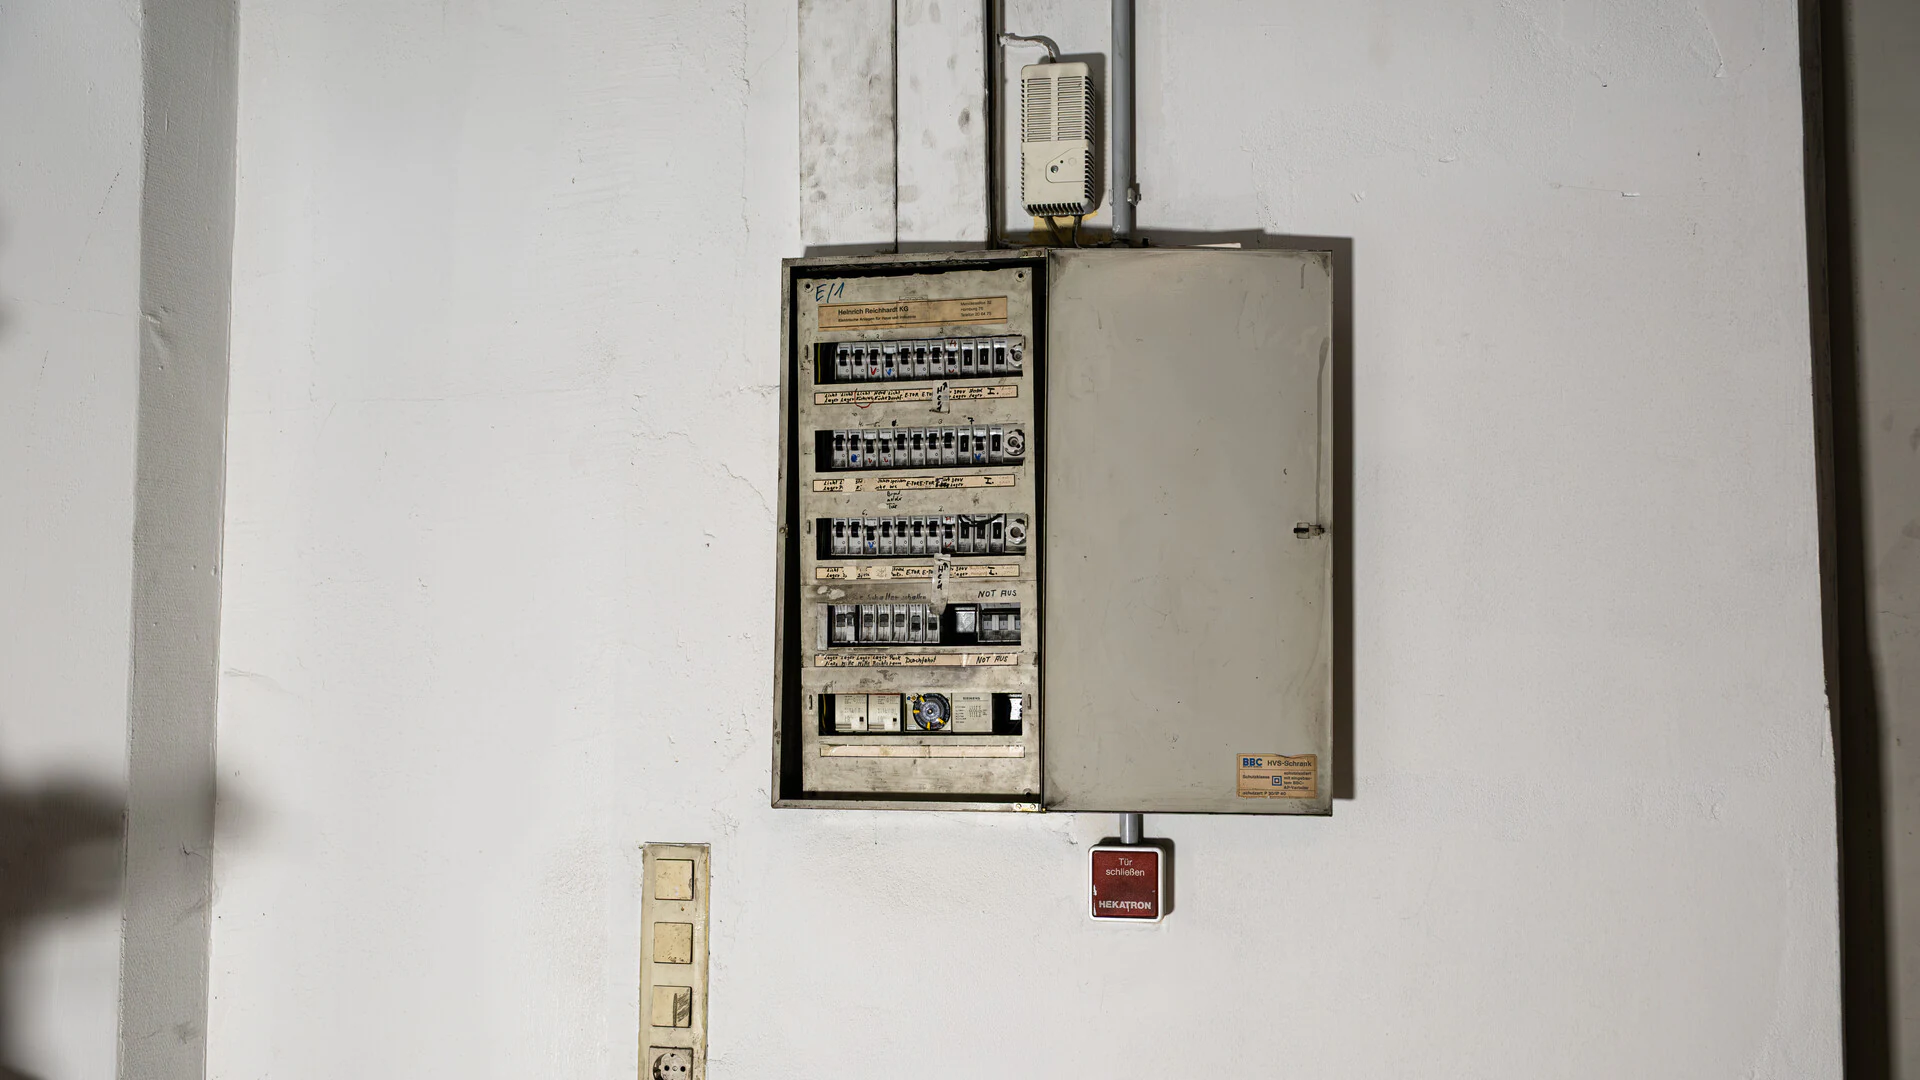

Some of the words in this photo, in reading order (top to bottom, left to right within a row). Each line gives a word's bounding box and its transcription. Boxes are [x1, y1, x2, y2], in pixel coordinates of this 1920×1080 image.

[816, 282, 845, 303] E/1
[838, 308, 864, 316] Heinrich
[865, 306, 898, 314] Reichhardt
[978, 590, 996, 598] NOT
[976, 656, 990, 664] NOT
[1243, 758, 1263, 767] BBC
[1119, 858, 1133, 866] Tür
[1105, 868, 1145, 877] schließen
[1098, 900, 1152, 910] HEKATRON
